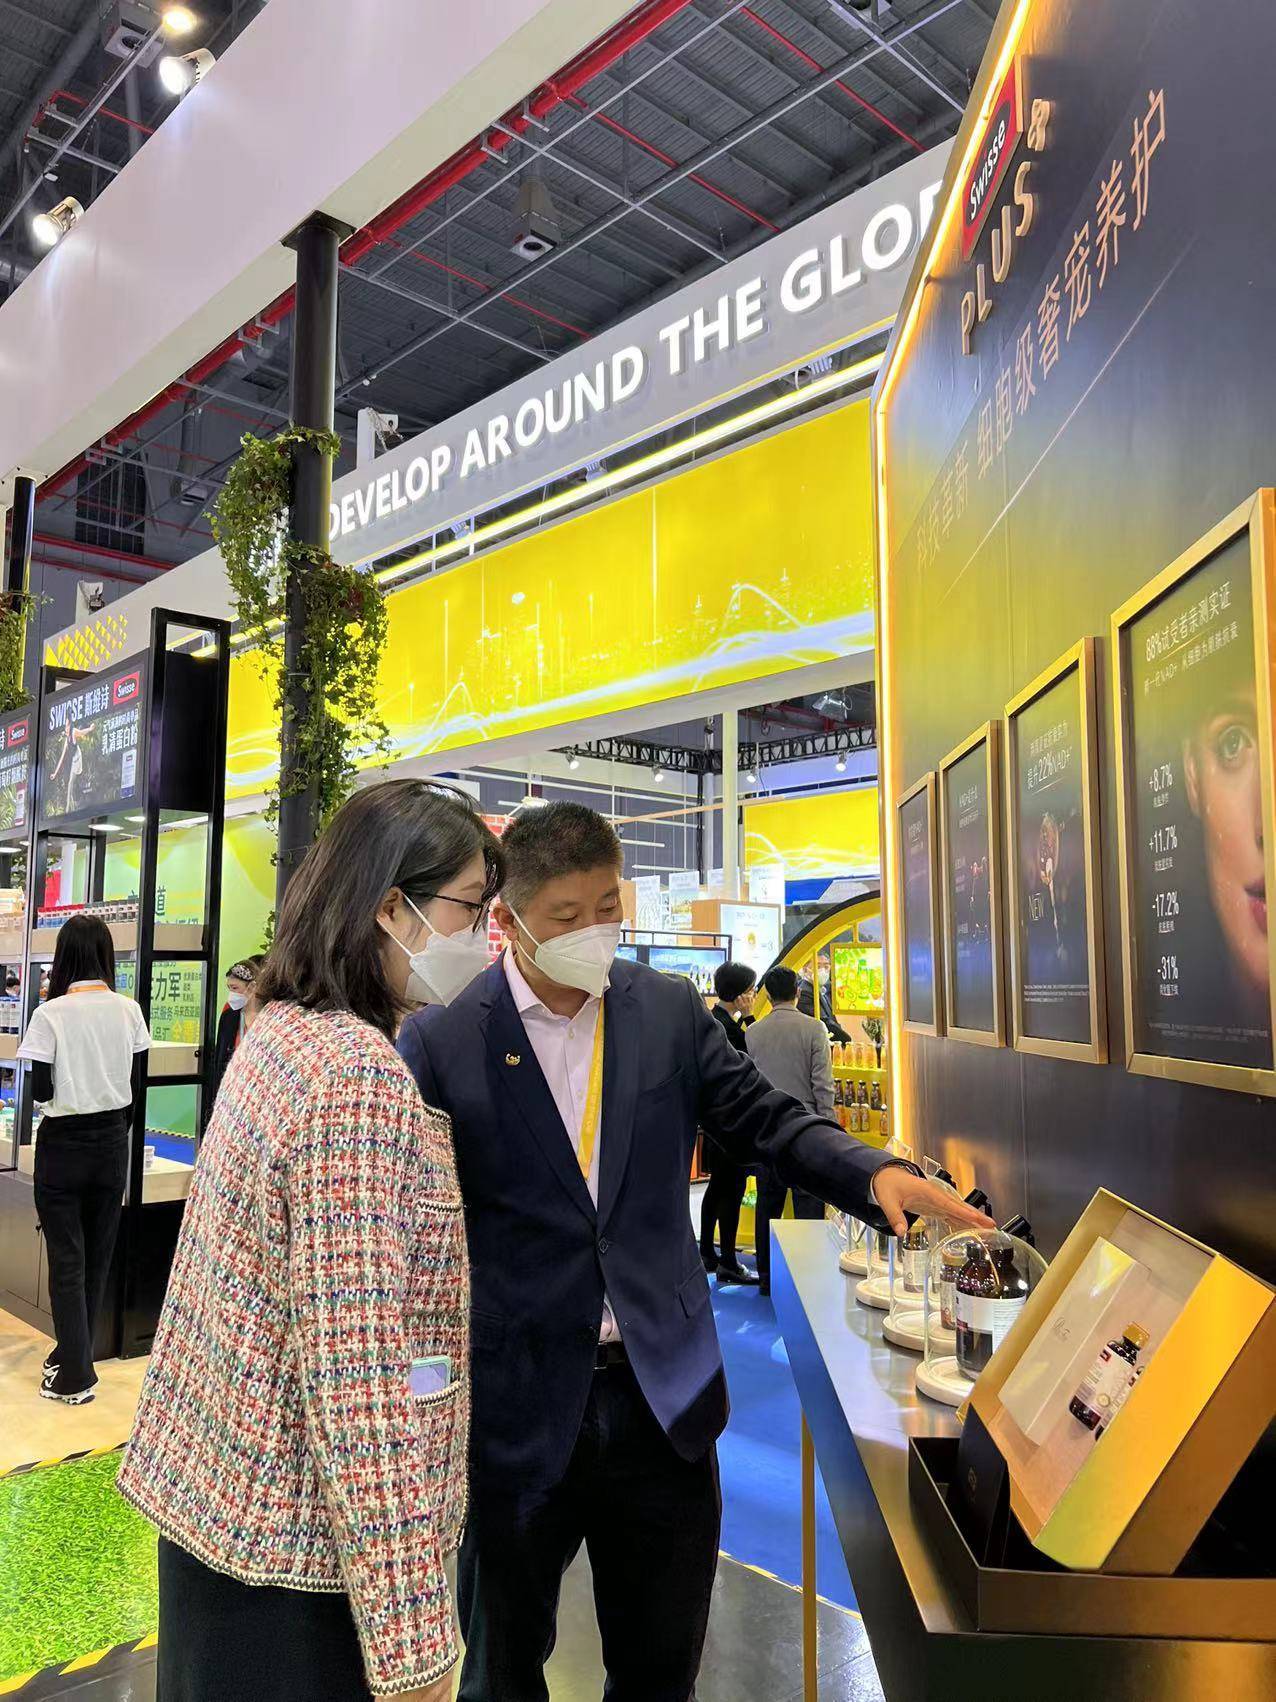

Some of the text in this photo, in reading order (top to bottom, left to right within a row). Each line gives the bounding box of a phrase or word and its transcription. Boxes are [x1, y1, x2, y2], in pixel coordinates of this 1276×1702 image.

[970, 119, 1006, 220] Swisse
[961, 161, 1034, 355] PLUS
[329, 445, 451, 541] DEVELOP
[460, 346, 644, 478] AROUND
[659, 277, 764, 375] THE
[117, 682, 135, 698] Swisse
[1149, 762, 1173, 792] +8.7%
[1149, 825, 1178, 853] +11.7%
[1152, 890, 1179, 917] -17.2%
[1157, 955, 1178, 980] -31%
[151, 971, 181, 1002] 力军
